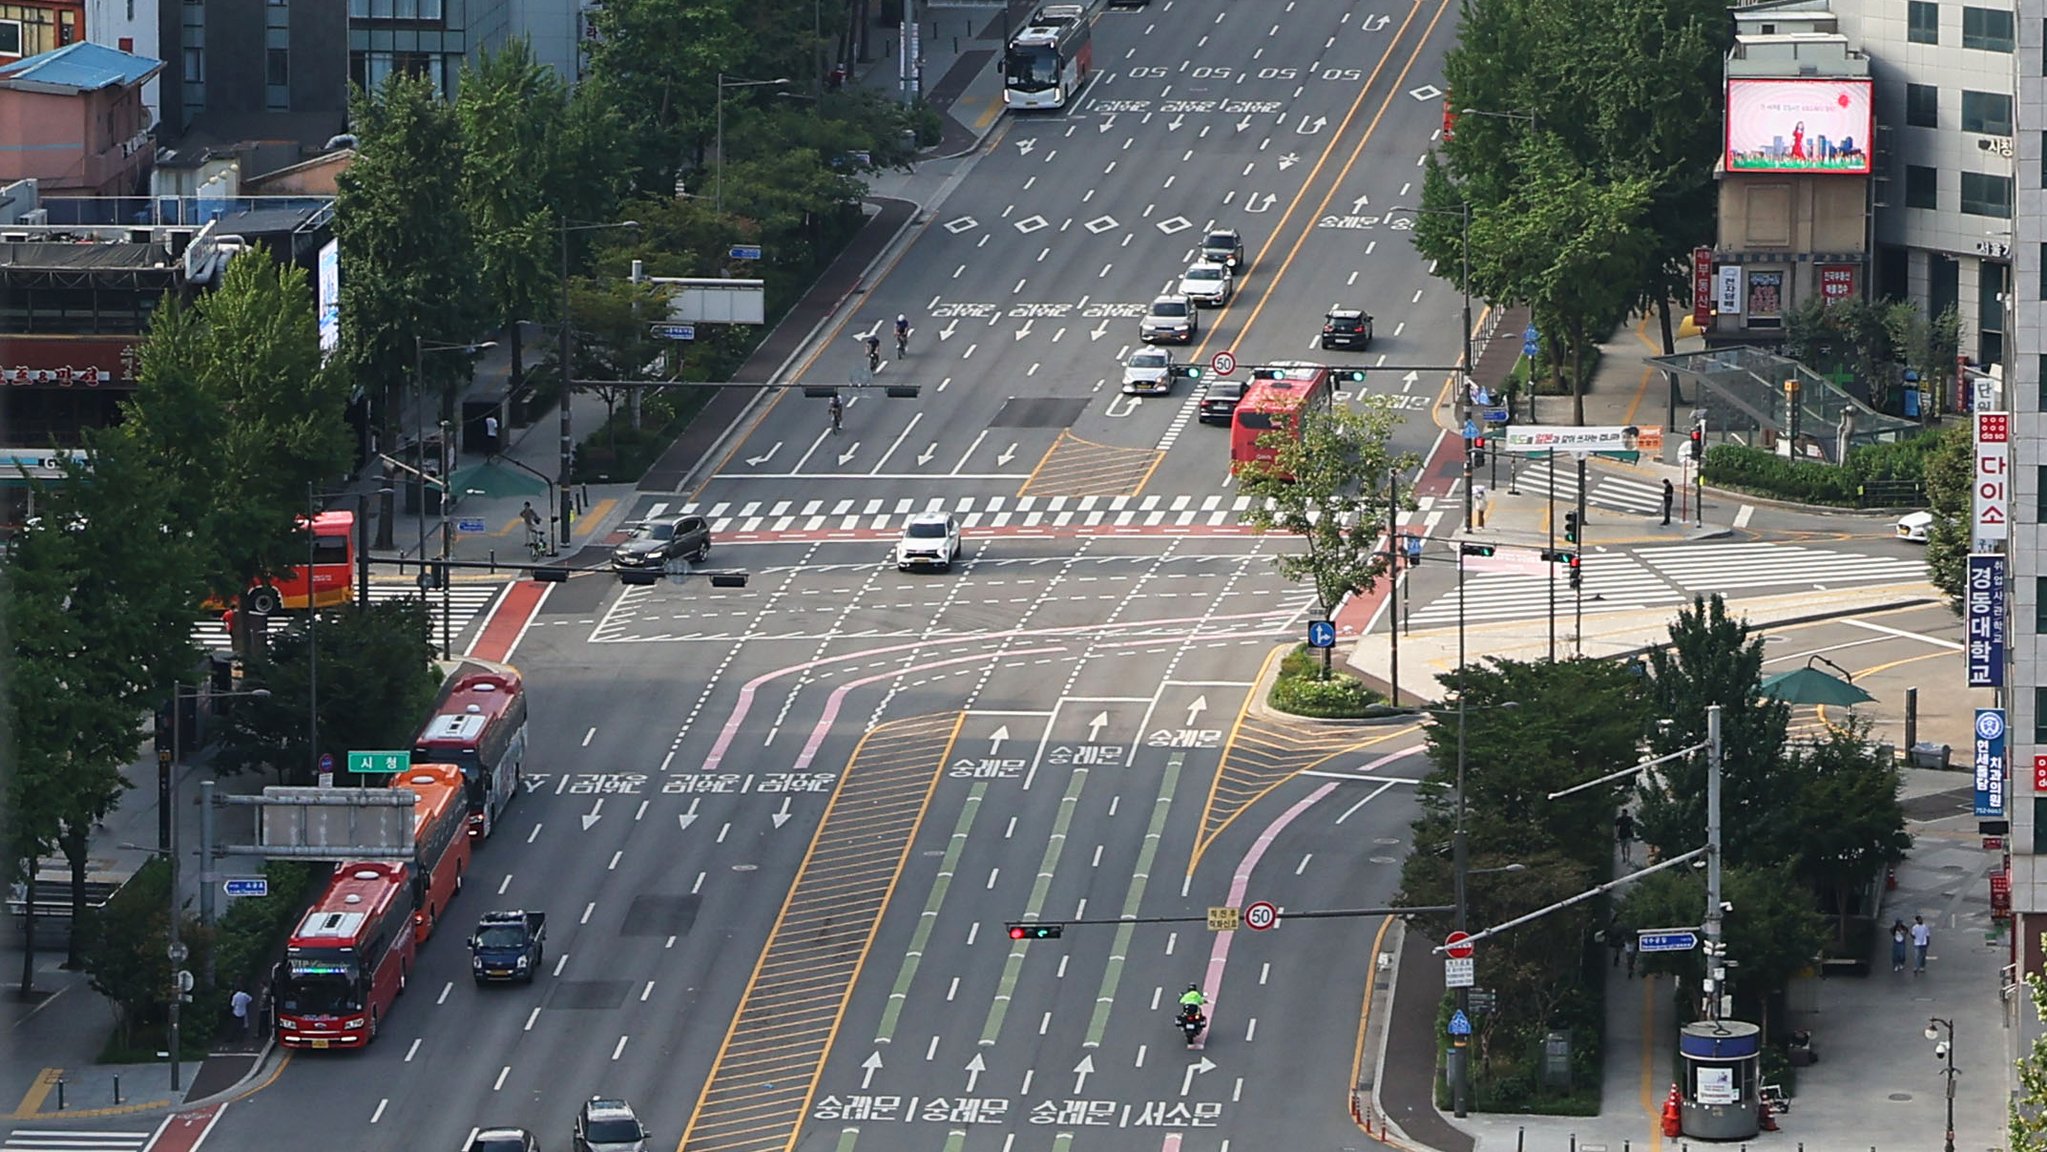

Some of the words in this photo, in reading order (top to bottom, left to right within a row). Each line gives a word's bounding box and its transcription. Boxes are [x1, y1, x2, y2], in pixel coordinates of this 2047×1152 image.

[1128, 67, 1168, 77] 50
[1192, 68, 1232, 78] 50
[1257, 69, 1297, 79] 50
[1322, 70, 1362, 80] 50
[1216, 355, 1232, 371] 50
[1980, 456, 2007, 525] 다이소
[1970, 567, 1992, 683] 경동대학교
[1048, 745, 1123, 765] 숭례문
[949, 758, 1026, 777] 숭례문
[569, 774, 648, 793] 광화문
[661, 774, 742, 793] 광화문
[758, 773, 837, 792] 광화문
[1989, 756, 2002, 807] 치과의원
[1252, 908, 1270, 924] 50
[813, 1095, 900, 1121] 숭례문
[922, 1097, 1009, 1123] 숭례문
[1029, 1099, 1116, 1125] 숭례문
[1134, 1101, 1223, 1127] 서소문
